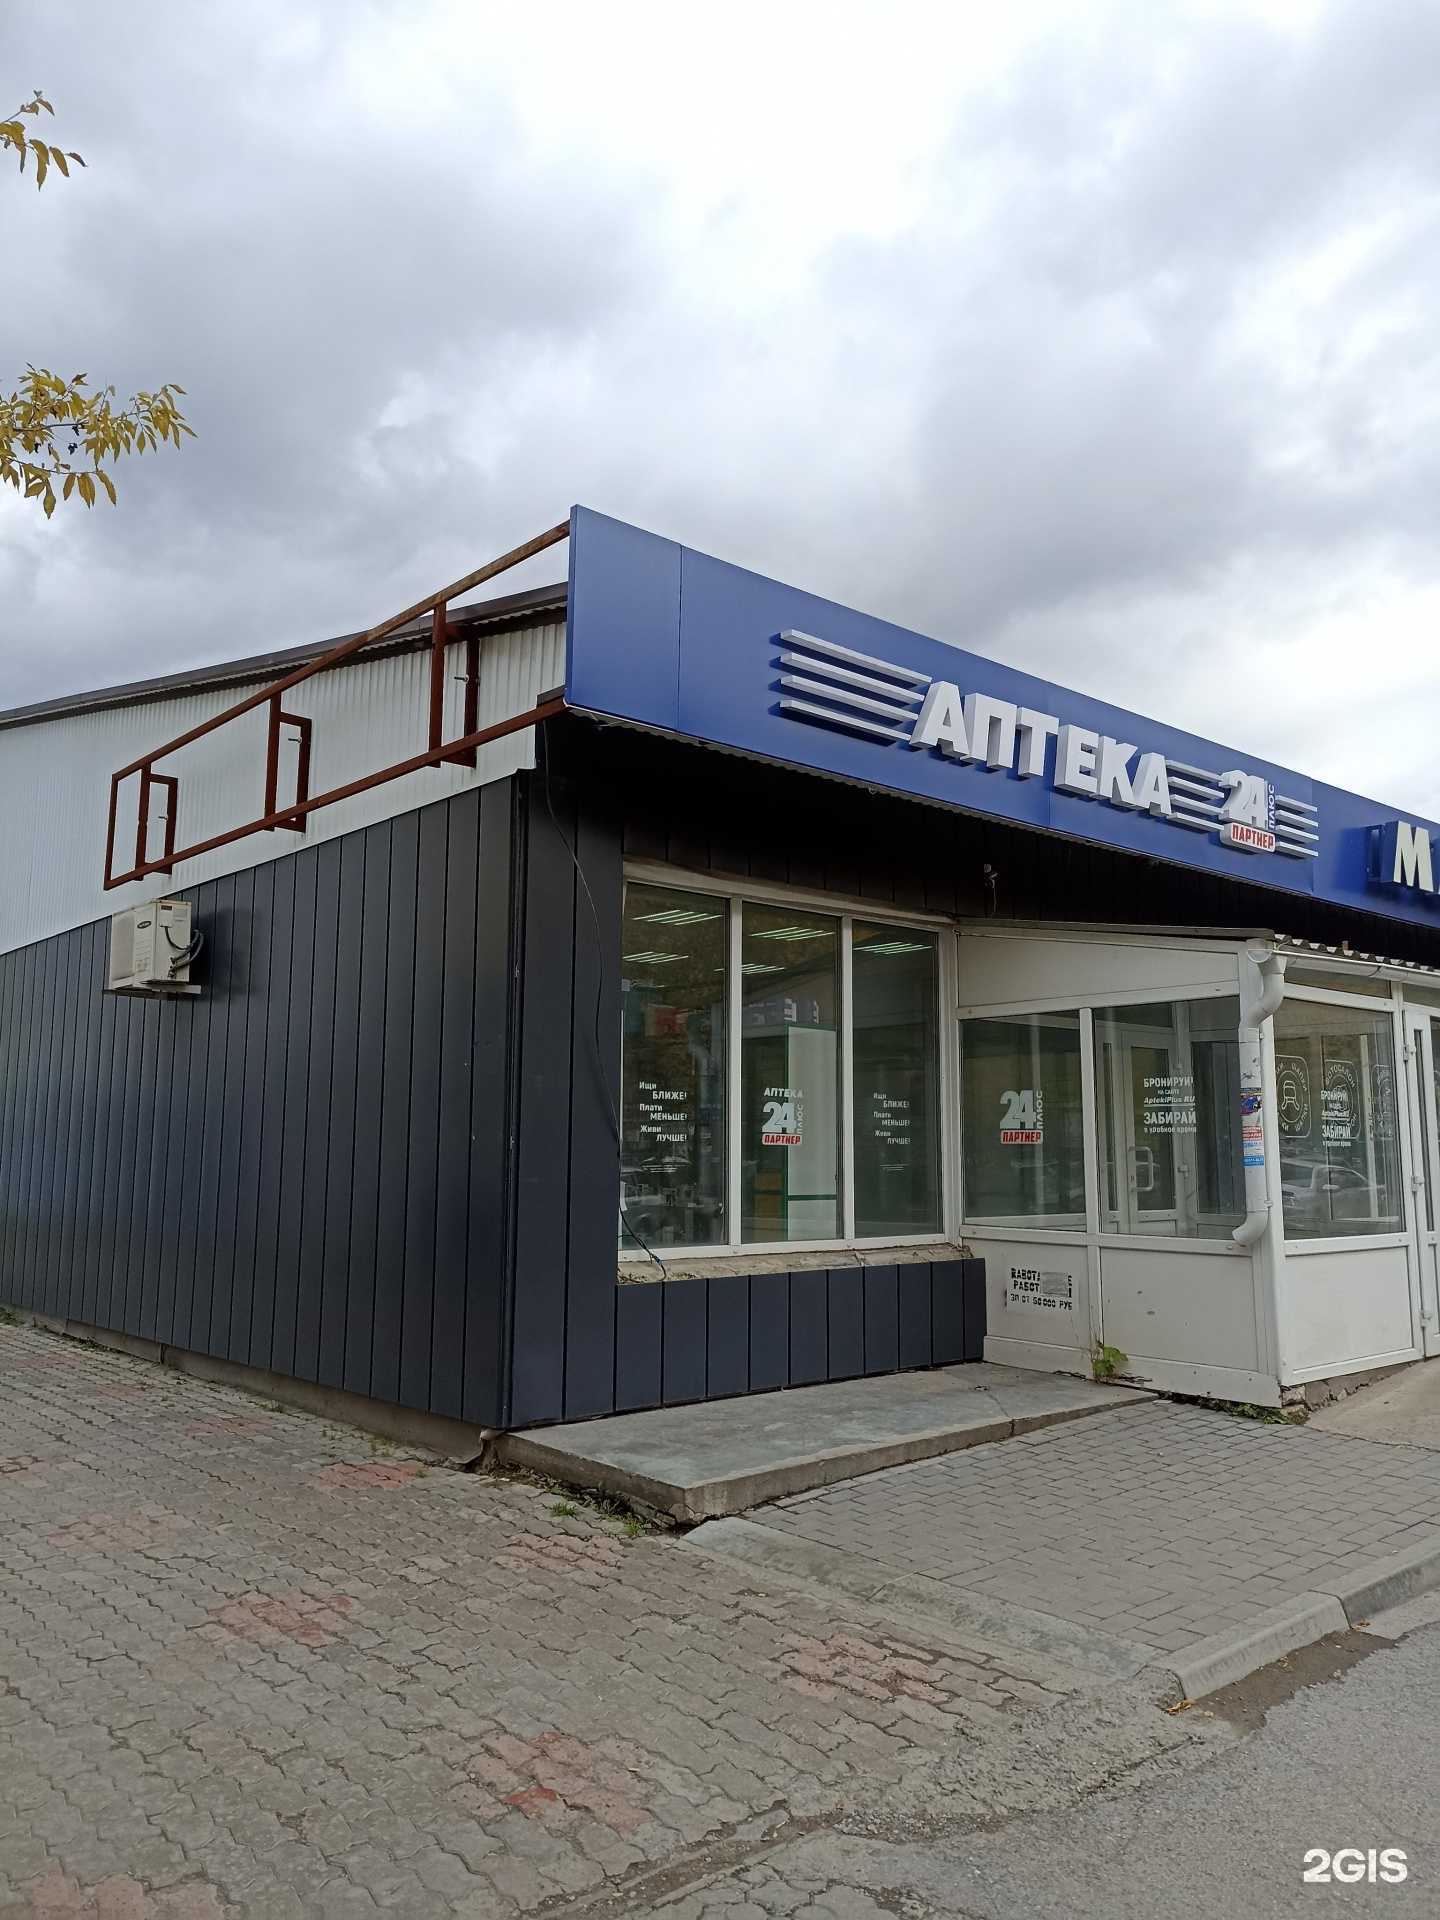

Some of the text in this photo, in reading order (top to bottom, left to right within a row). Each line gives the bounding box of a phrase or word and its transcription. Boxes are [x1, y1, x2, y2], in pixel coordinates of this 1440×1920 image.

[909, 681, 1172, 816] АПТЕКА
[1218, 770, 1268, 830] 24
[1231, 823, 1274, 850] ПАРТНЕР
[1392, 820, 1440, 894] М
[639, 1081, 657, 1090] Ищи
[652, 1090, 687, 1100] БЛИЖЕ!
[764, 1087, 804, 1098] АПТЕКА
[639, 1103, 663, 1111] Плати
[1000, 1089, 1036, 1129] 24
[650, 1112, 688, 1121] МЕНЬШЕ!
[762, 1101, 797, 1134] 24
[1143, 1107, 1197, 1124] ЗАБИРАЙ
[640, 1124, 662, 1133] Живи
[656, 1133, 687, 1142] ЛУЧШЕ!
[764, 1134, 801, 1145] ПАРТНЕР
[1002, 1131, 1042, 1143] ПАРТНЕР
